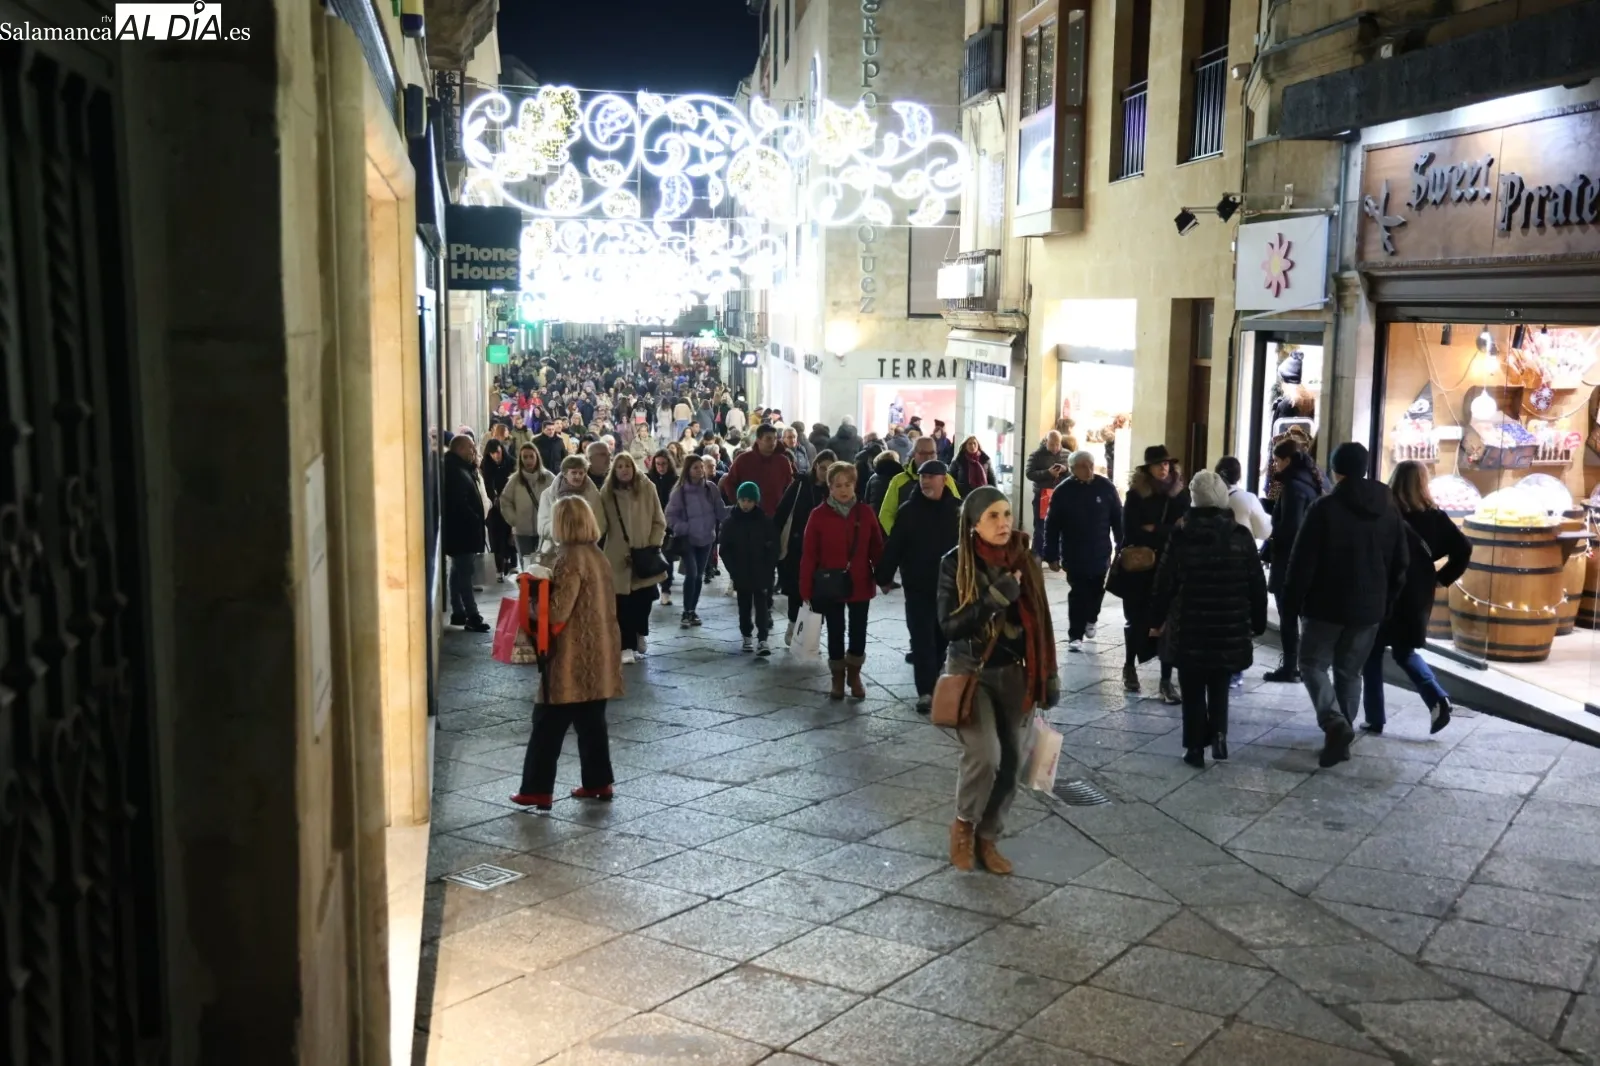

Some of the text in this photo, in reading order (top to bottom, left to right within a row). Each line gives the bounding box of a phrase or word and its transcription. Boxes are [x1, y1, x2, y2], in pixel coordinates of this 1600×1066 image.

[1407, 151, 1495, 210] Sweet
[451, 243, 519, 261] Phone
[451, 262, 518, 280] House
